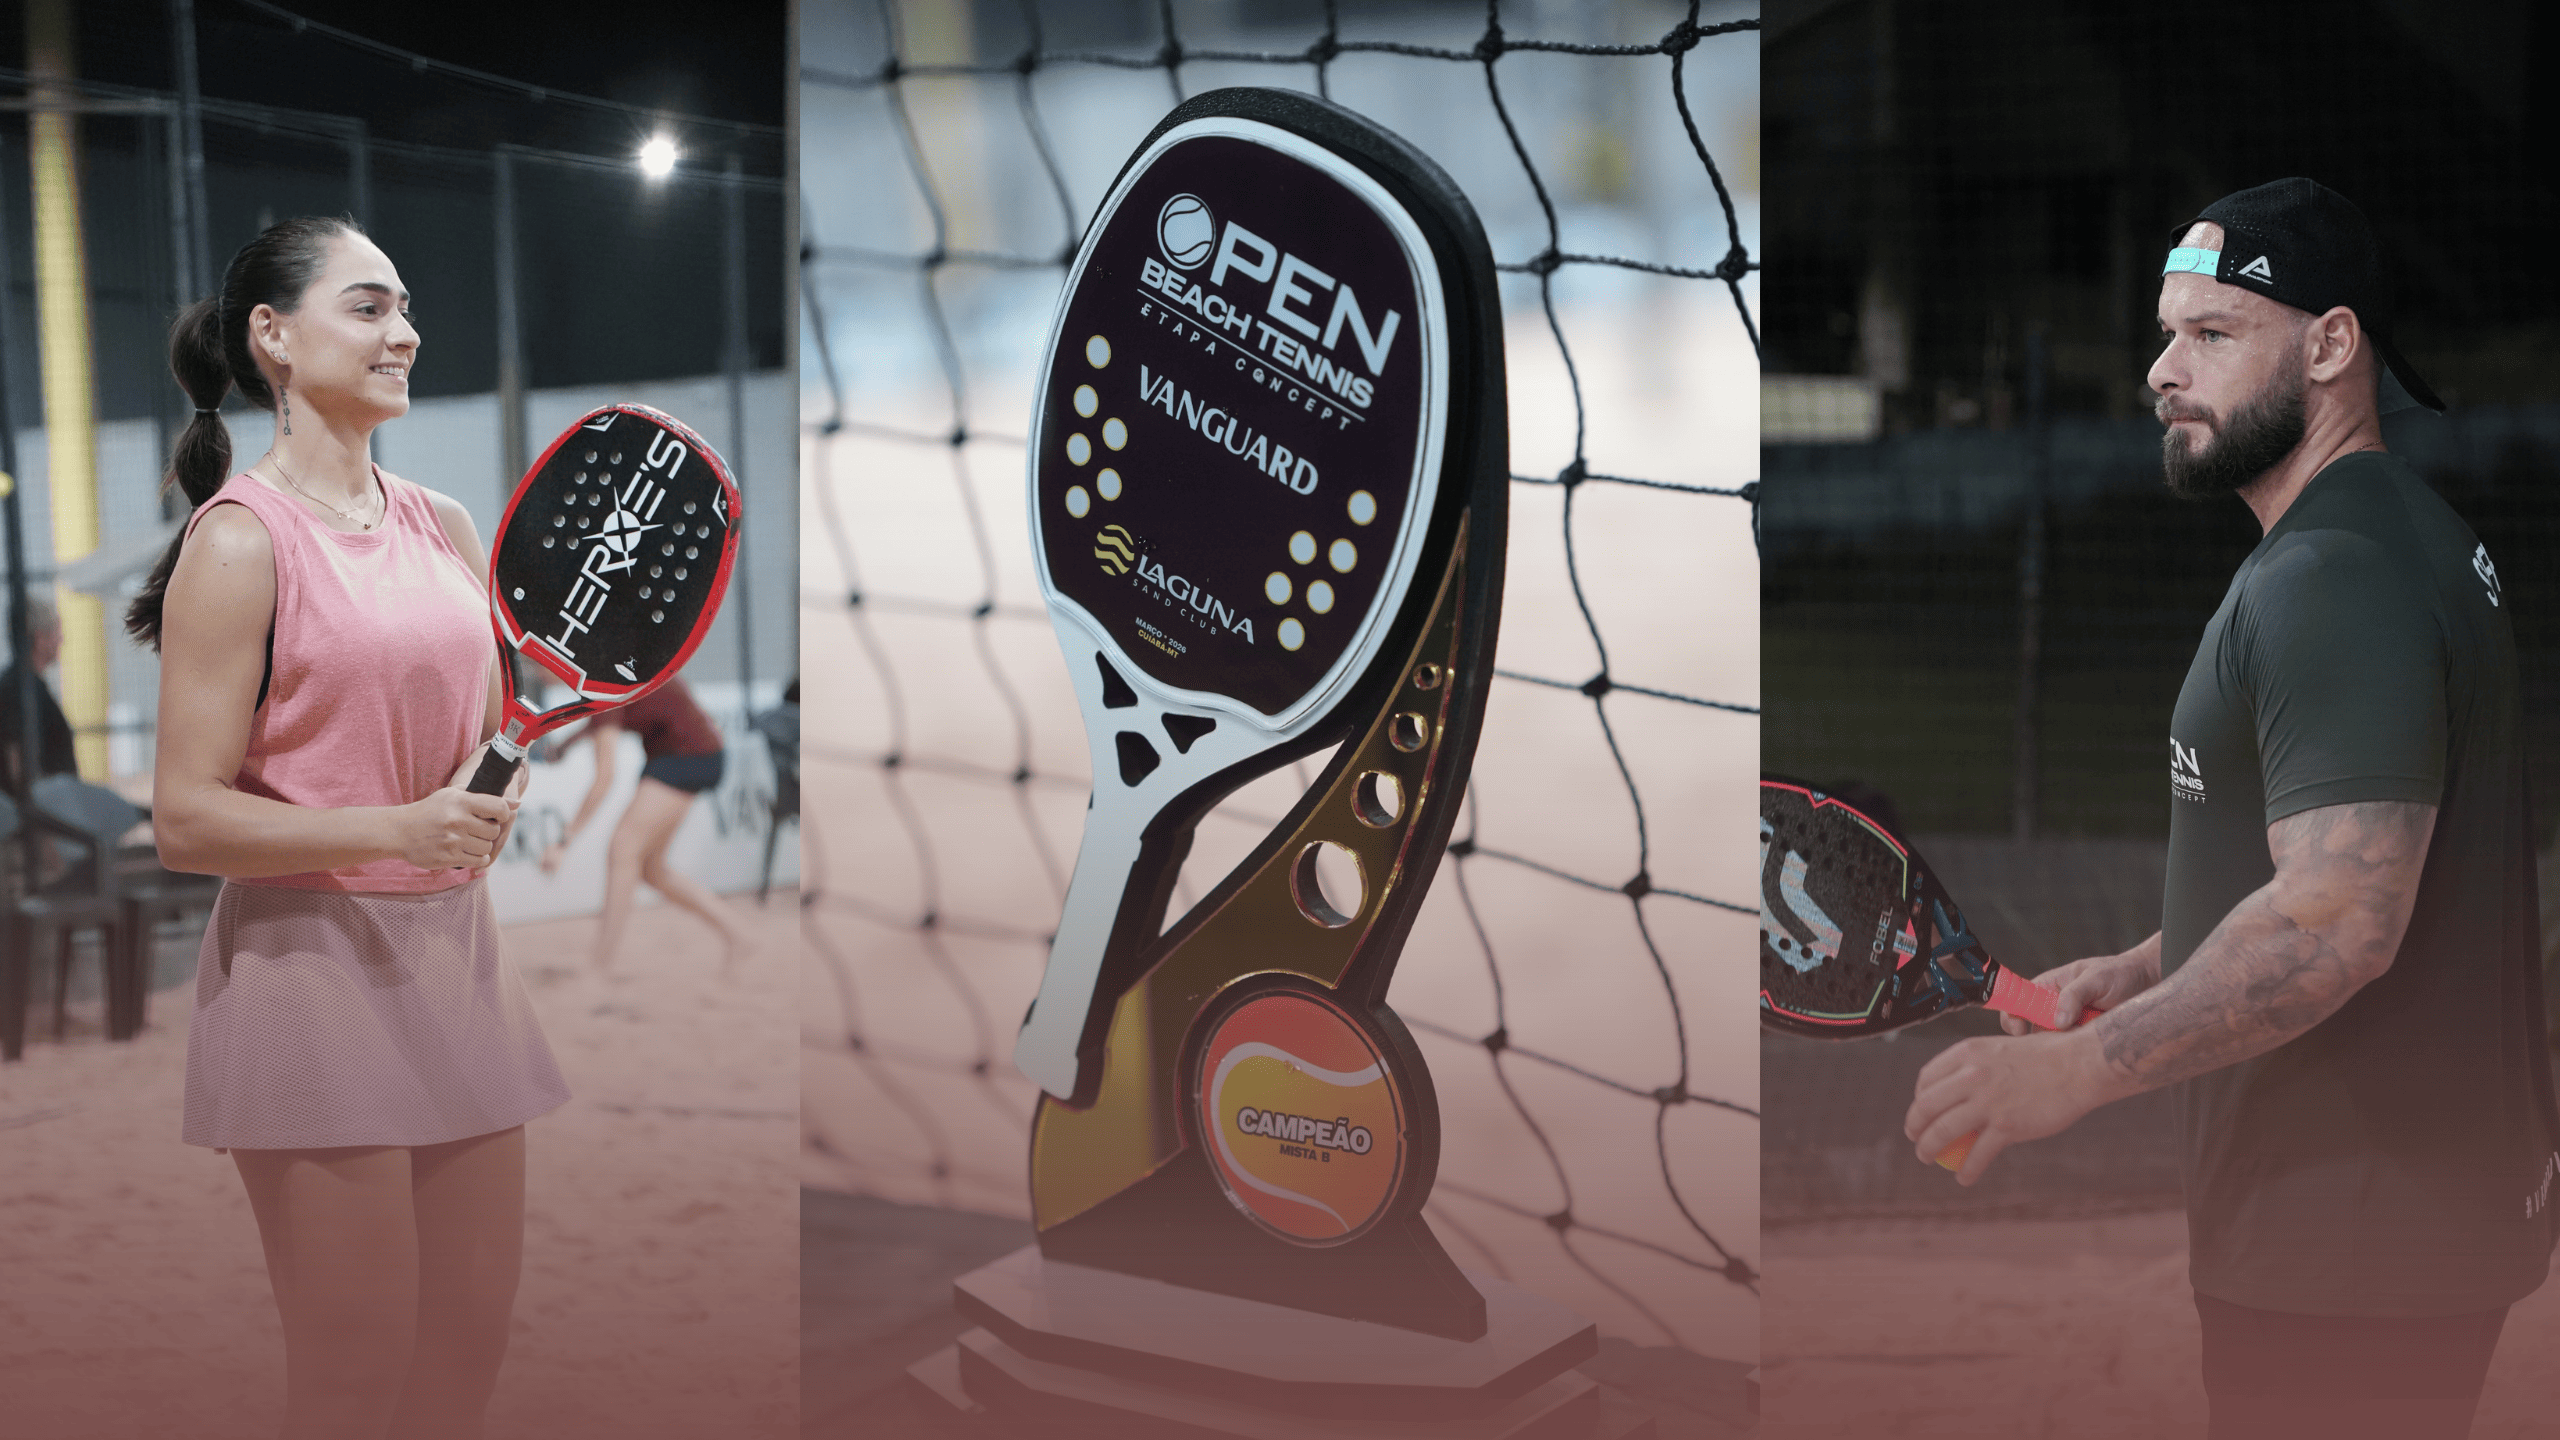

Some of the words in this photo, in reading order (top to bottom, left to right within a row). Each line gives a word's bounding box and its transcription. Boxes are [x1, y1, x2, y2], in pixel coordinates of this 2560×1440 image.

[1140, 256, 1252, 340] BEACH
[1255, 320, 1374, 409] TENNIS
[1141, 303, 1217, 355] ETAPA
[1235, 358, 1351, 430] CONCEPT
[1140, 364, 1319, 495] VANGUARD
[1132, 578, 1171, 607] SAND
[1180, 608, 1217, 635] CLUB
[1136, 554, 1254, 645] LAGUNA
[1135, 617, 1163, 638] MARÇO
[1168, 638, 1187, 653] 2026
[2171, 768, 2204, 790] ENNIS
[1870, 906, 1893, 966] FOBEL
[1237, 1107, 1372, 1155] CAMPEÃO
[1279, 1144, 1317, 1161] MISTA
[1321, 1152, 1330, 1163] B
